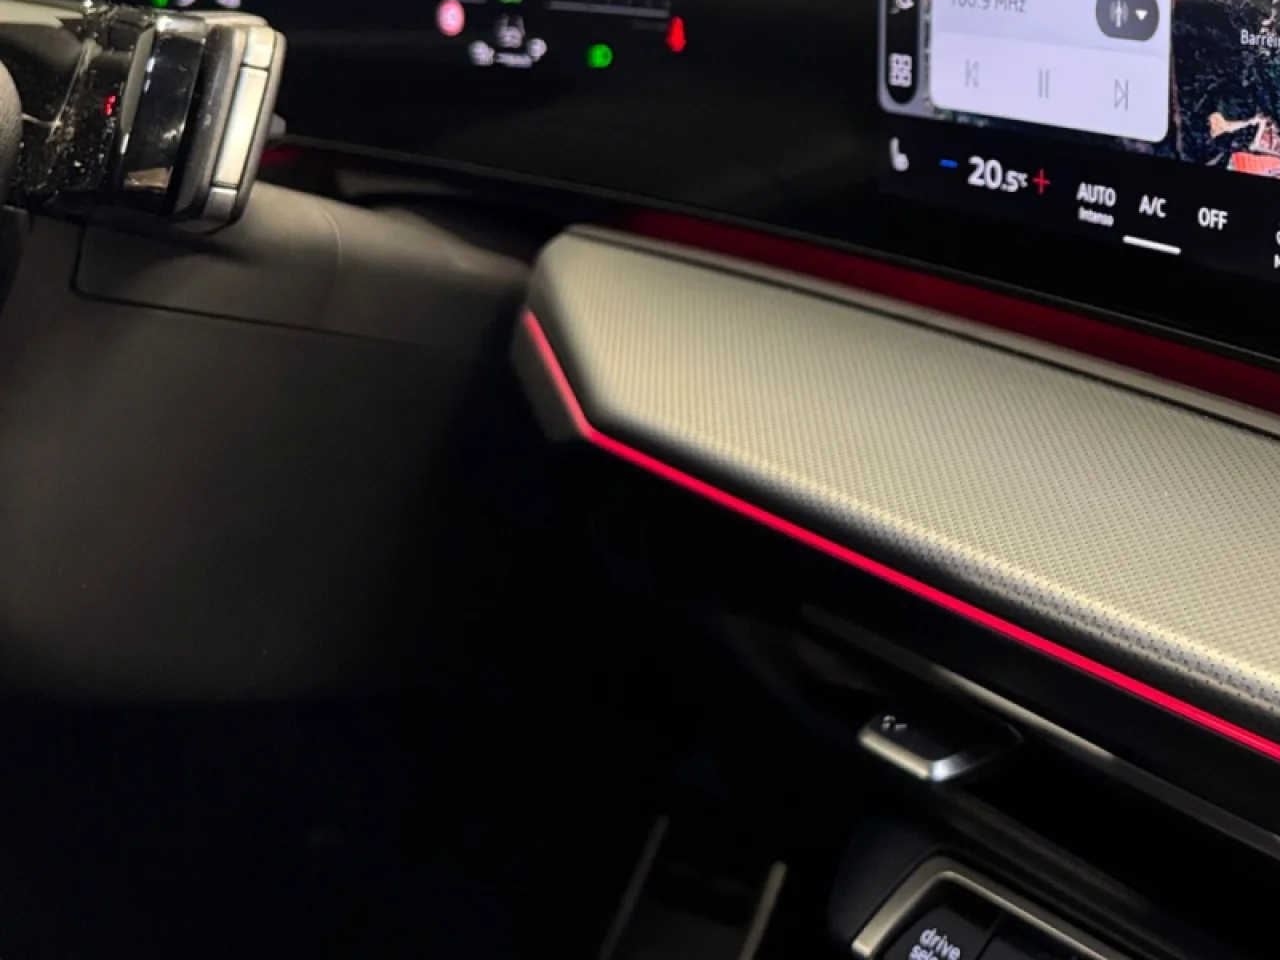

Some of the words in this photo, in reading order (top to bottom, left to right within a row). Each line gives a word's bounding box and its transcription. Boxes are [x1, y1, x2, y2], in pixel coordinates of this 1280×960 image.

[1075, 181, 1117, 208] AUTO
[1138, 194, 1167, 220] A/C
[1198, 206, 1228, 231] OFF
[919, 927, 961, 960] drive
